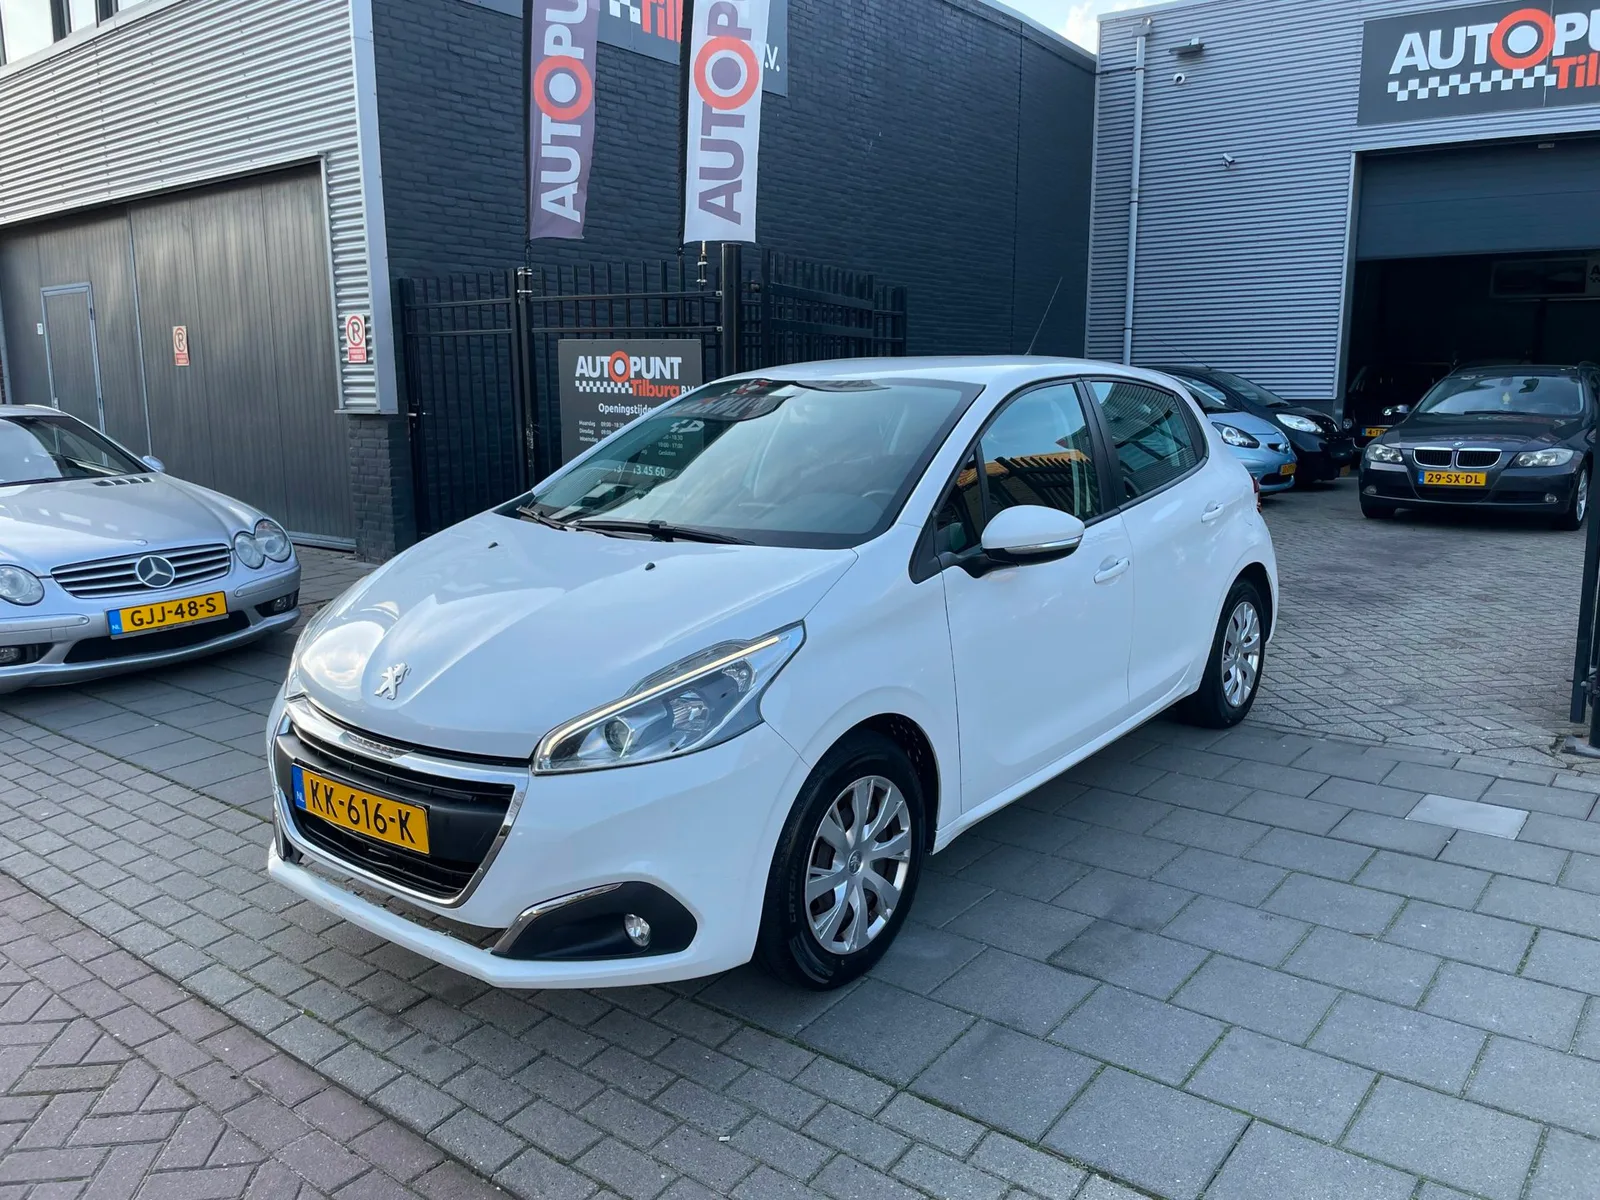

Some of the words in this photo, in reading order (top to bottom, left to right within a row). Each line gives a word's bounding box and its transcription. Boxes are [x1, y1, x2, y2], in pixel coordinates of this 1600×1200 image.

[641, 0, 682, 43] Til
[1552, 52, 1600, 90] Til
[575, 350, 682, 383] AUTOPUNT
[1427, 473, 1481, 485] 29-SX-DL
[130, 597, 217, 627] GJJ-48-S
[309, 778, 416, 845] KK-616-K
